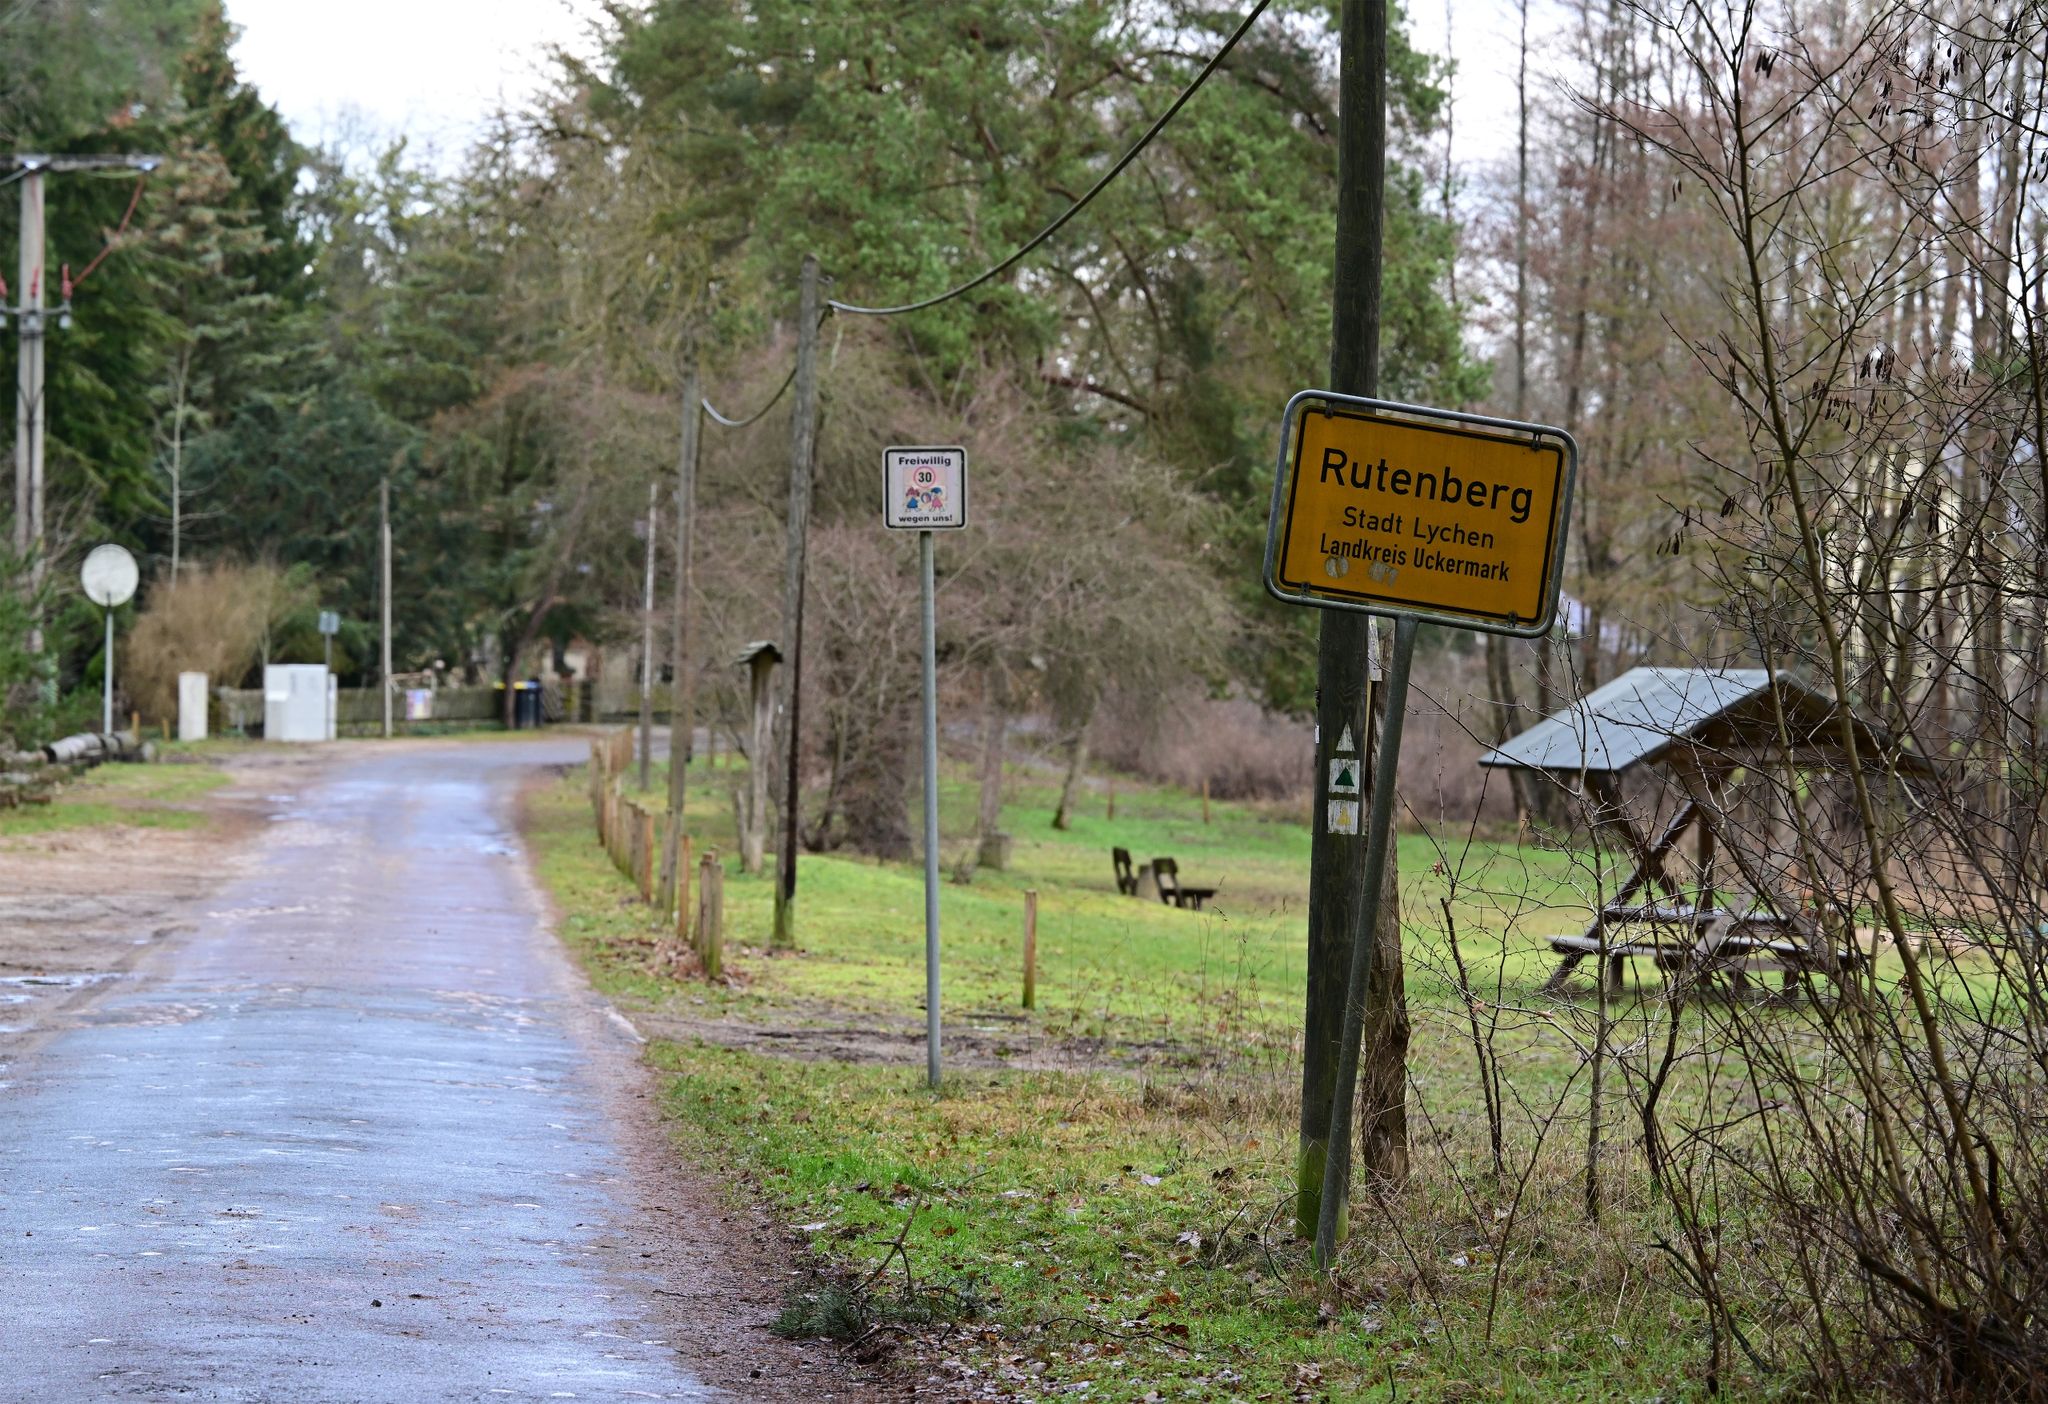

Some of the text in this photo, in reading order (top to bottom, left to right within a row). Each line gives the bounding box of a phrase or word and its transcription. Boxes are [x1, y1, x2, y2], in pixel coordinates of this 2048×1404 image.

[898, 456, 951, 467] Freiwillig
[918, 472, 932, 483] 30
[1320, 447, 1532, 523] Rutenberg
[933, 514, 952, 522] uns!
[1342, 506, 1494, 549] Stadt Lychen
[1320, 533, 1510, 582] Landkreis Uckermark
